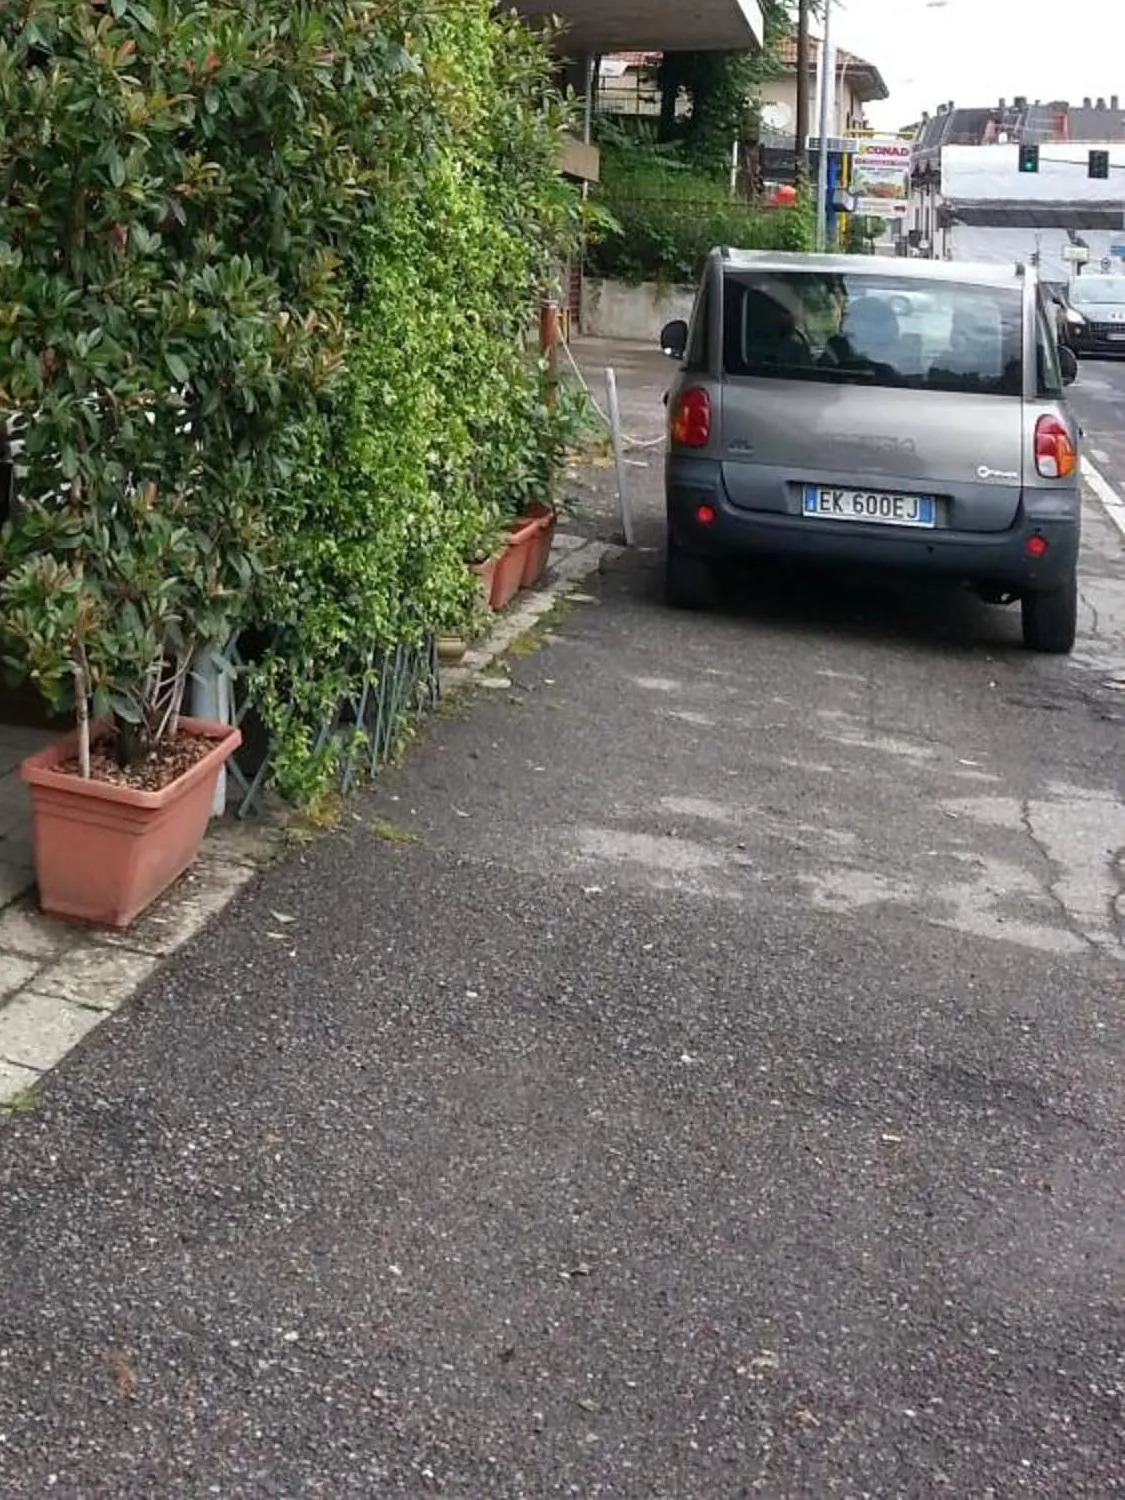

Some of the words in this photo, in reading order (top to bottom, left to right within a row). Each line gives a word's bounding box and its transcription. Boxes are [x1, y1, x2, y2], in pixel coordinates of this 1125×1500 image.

[866, 145, 910, 156] CONAD
[819, 491, 844, 513] EK
[852, 492, 919, 519] 600EJ
